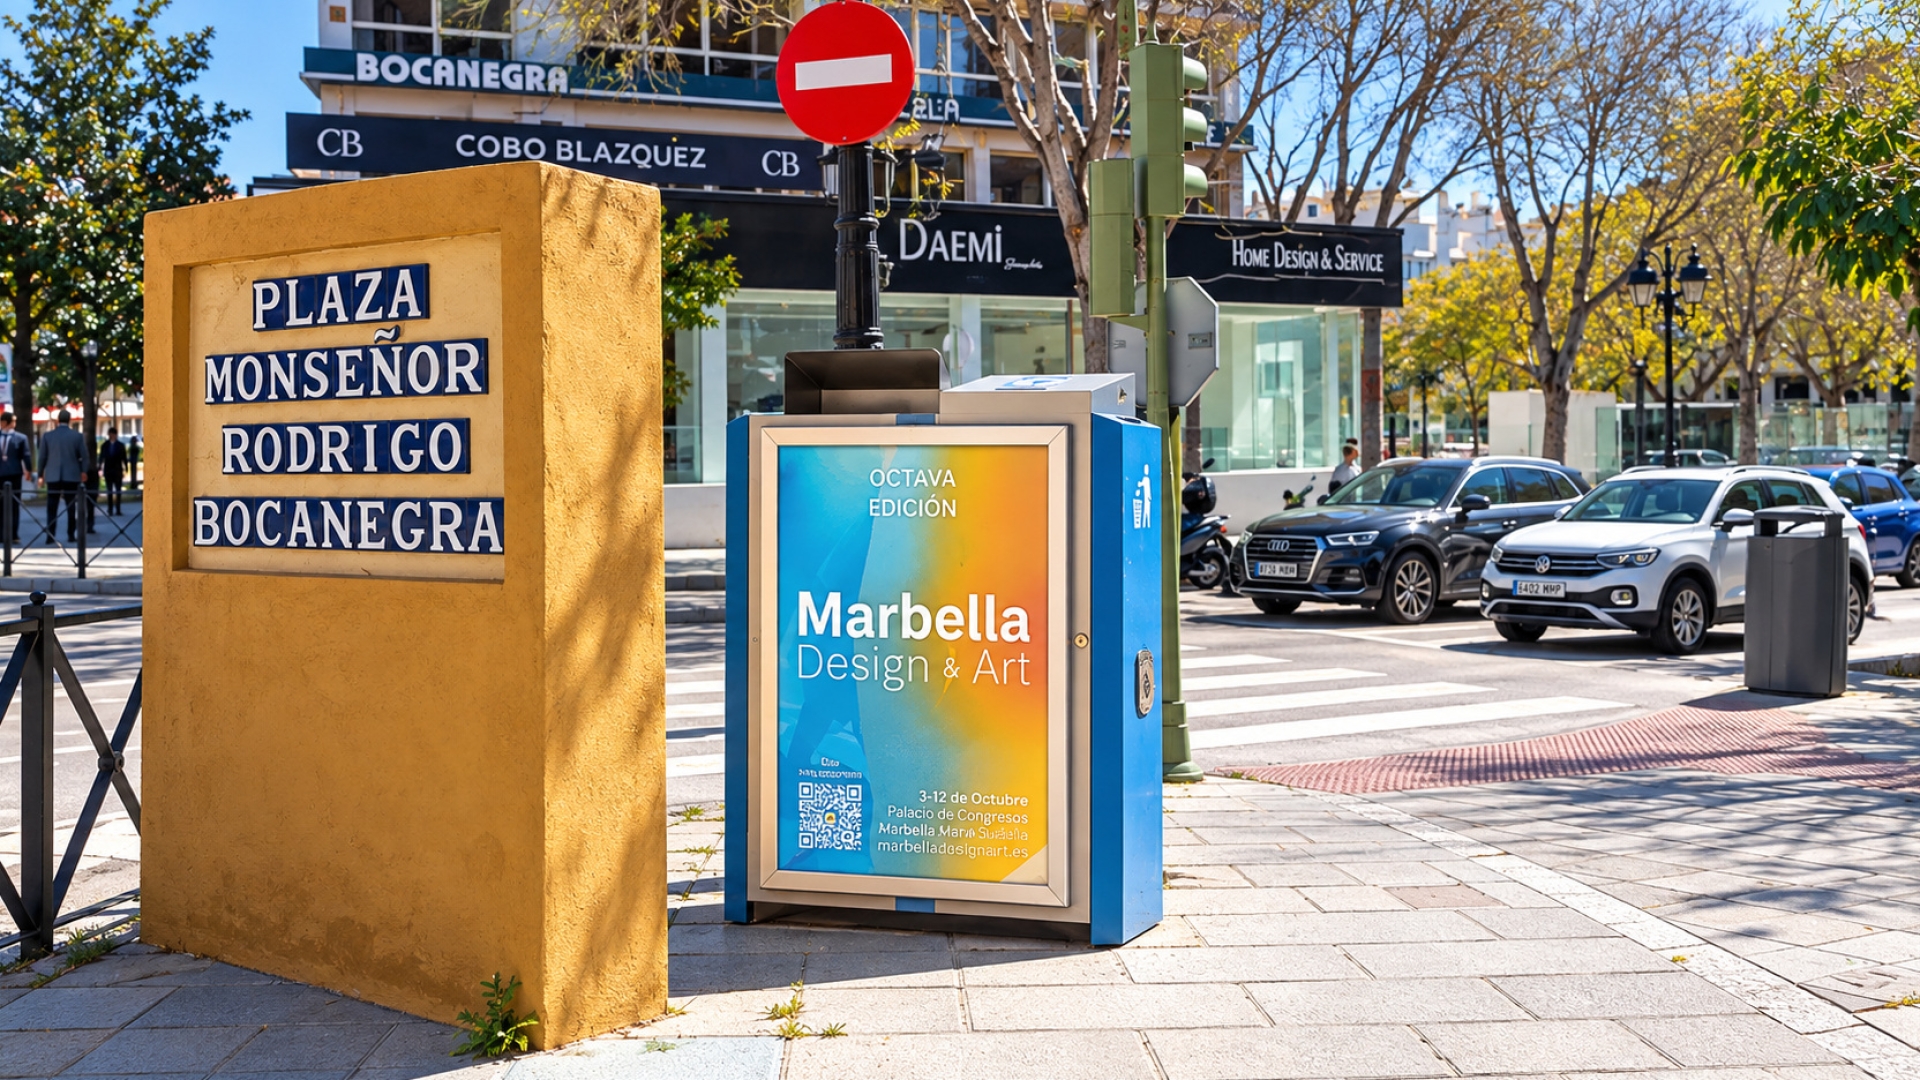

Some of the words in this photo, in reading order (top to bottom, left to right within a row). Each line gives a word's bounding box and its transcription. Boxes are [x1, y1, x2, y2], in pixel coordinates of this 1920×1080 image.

[356, 53, 568, 94] BOCANEGRA
[316, 128, 363, 158] CB
[455, 134, 546, 160] COBO
[556, 139, 706, 169] BLAZQUEZ
[761, 150, 800, 178] CB
[1335, 244, 1384, 272] SERVICE
[253, 269, 421, 329] PLAZA
[205, 326, 482, 403] MONSEÑOR
[222, 422, 461, 473] RODRIGO
[869, 469, 956, 487] OCTAVA
[869, 494, 956, 517] EDICIÓN
[194, 500, 503, 552] BOCANEGRA
[798, 591, 1030, 642] Marbella
[798, 644, 928, 691] Design
[943, 657, 960, 678] &
[972, 649, 1030, 685] Art
[919, 790, 946, 802] 3-12
[951, 792, 967, 804] de
[971, 792, 1028, 806] Octubre
[878, 822, 935, 836] Marbella
[888, 805, 934, 819] Palacio
[937, 809, 954, 820] de
[957, 809, 1028, 825] Congresos
